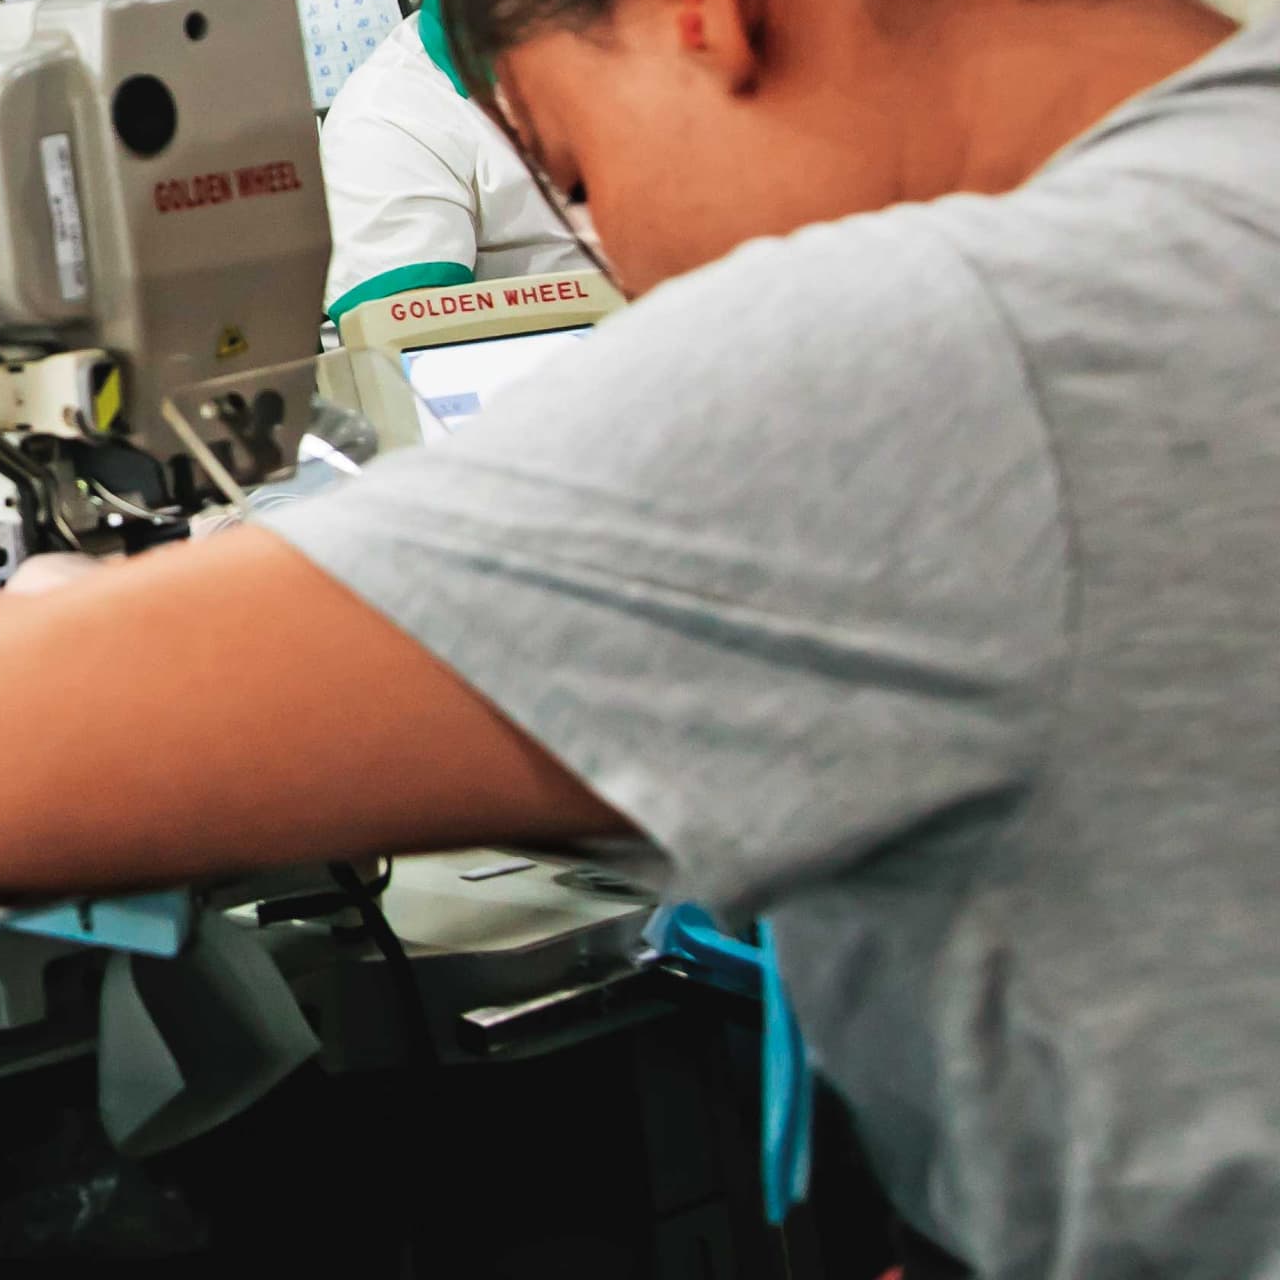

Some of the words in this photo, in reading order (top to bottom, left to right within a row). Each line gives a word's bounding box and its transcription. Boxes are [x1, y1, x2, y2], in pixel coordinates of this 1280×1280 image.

[154, 172, 233, 213] GOLDEN
[236, 161, 302, 199] WHEEL
[391, 292, 495, 321] GOLDEN
[503, 280, 590, 307] WHEEL
